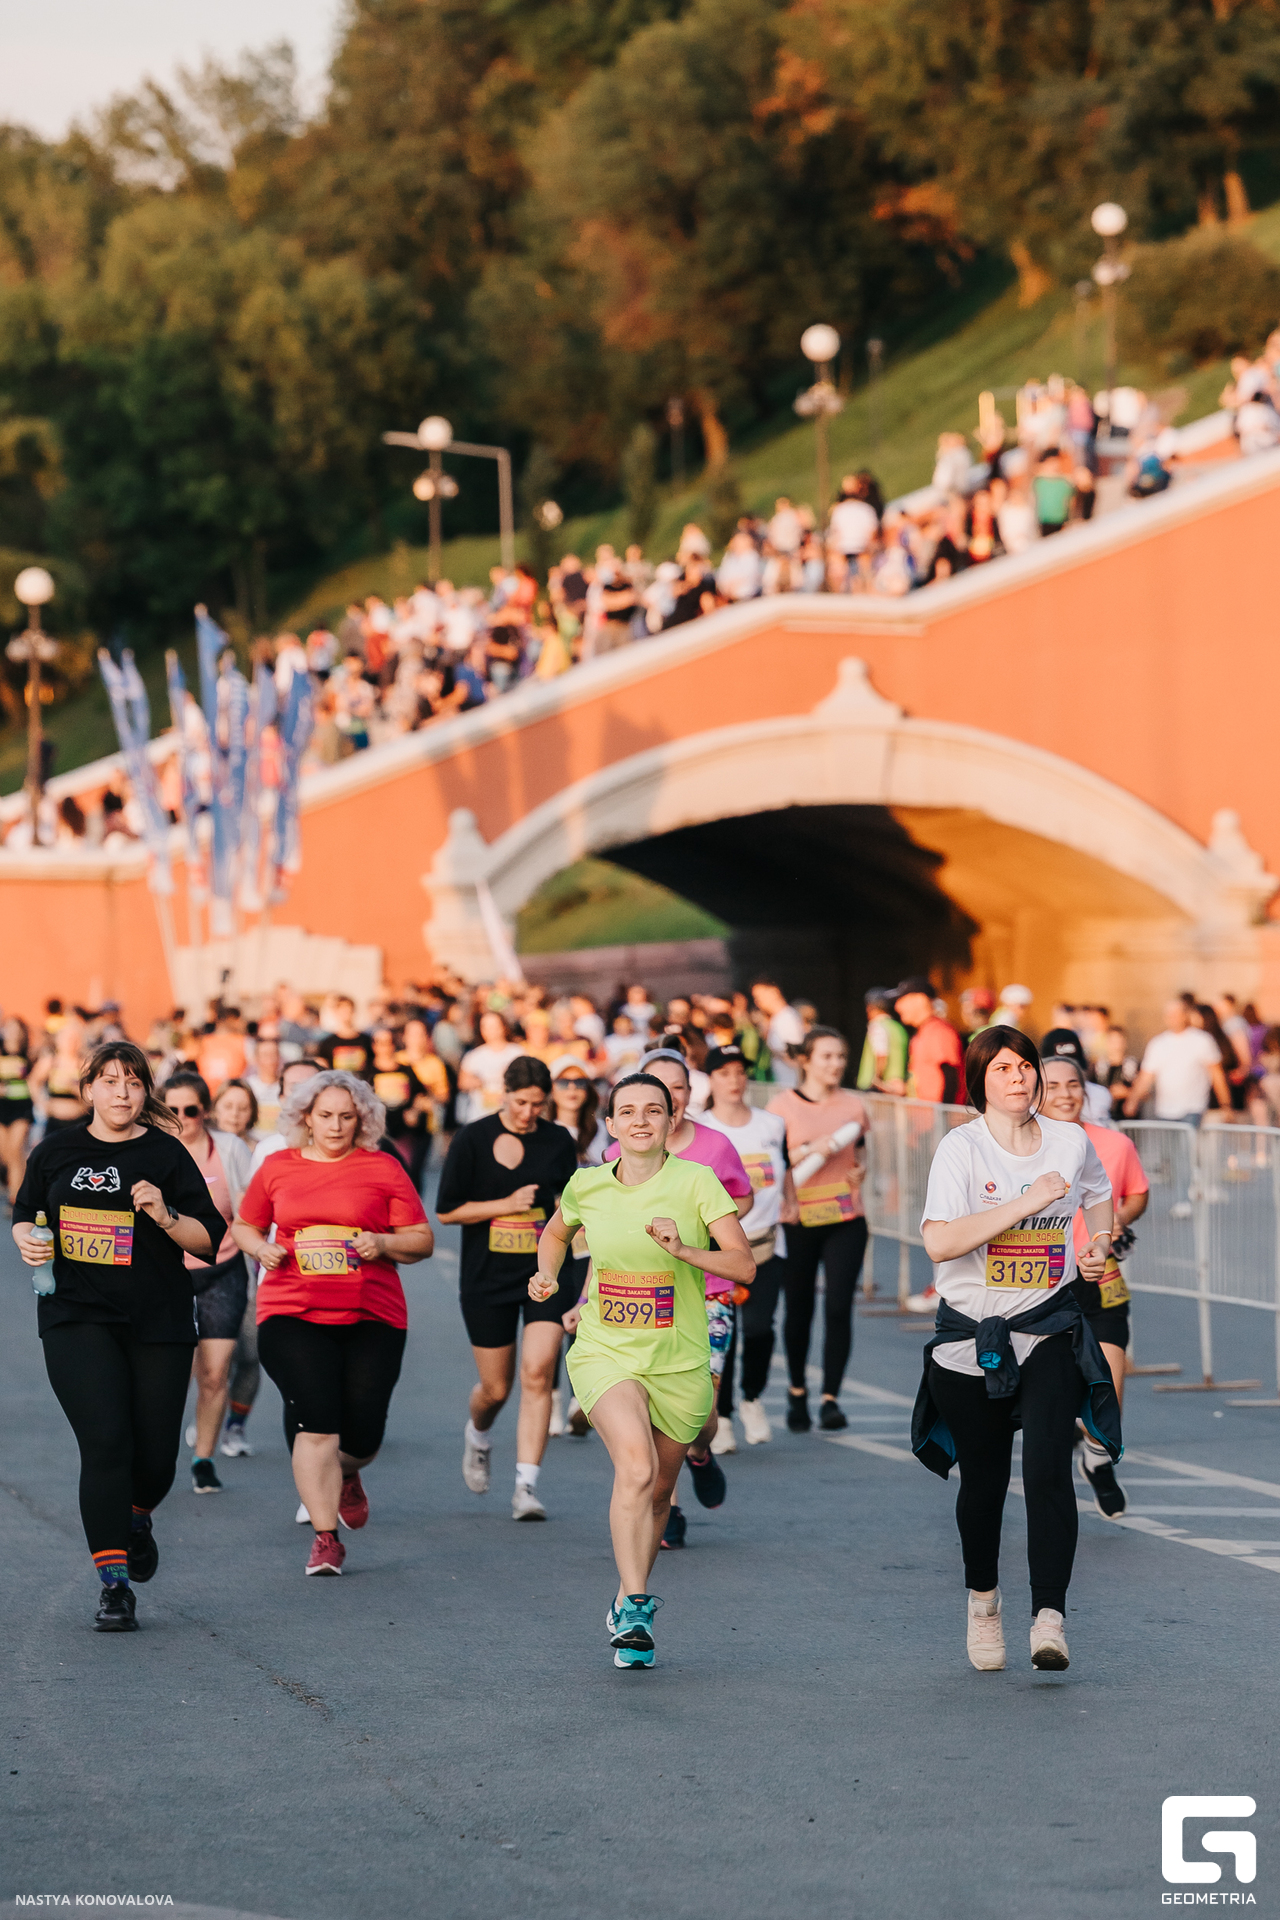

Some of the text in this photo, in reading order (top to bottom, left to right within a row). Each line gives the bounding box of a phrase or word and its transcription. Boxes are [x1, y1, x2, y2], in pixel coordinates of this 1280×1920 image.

[64, 1235, 113, 1259] 3167
[494, 1230, 536, 1249] 2317
[300, 1251, 345, 1271] 2039
[991, 1260, 1047, 1284] 3137
[603, 1299, 654, 1325] 2399
